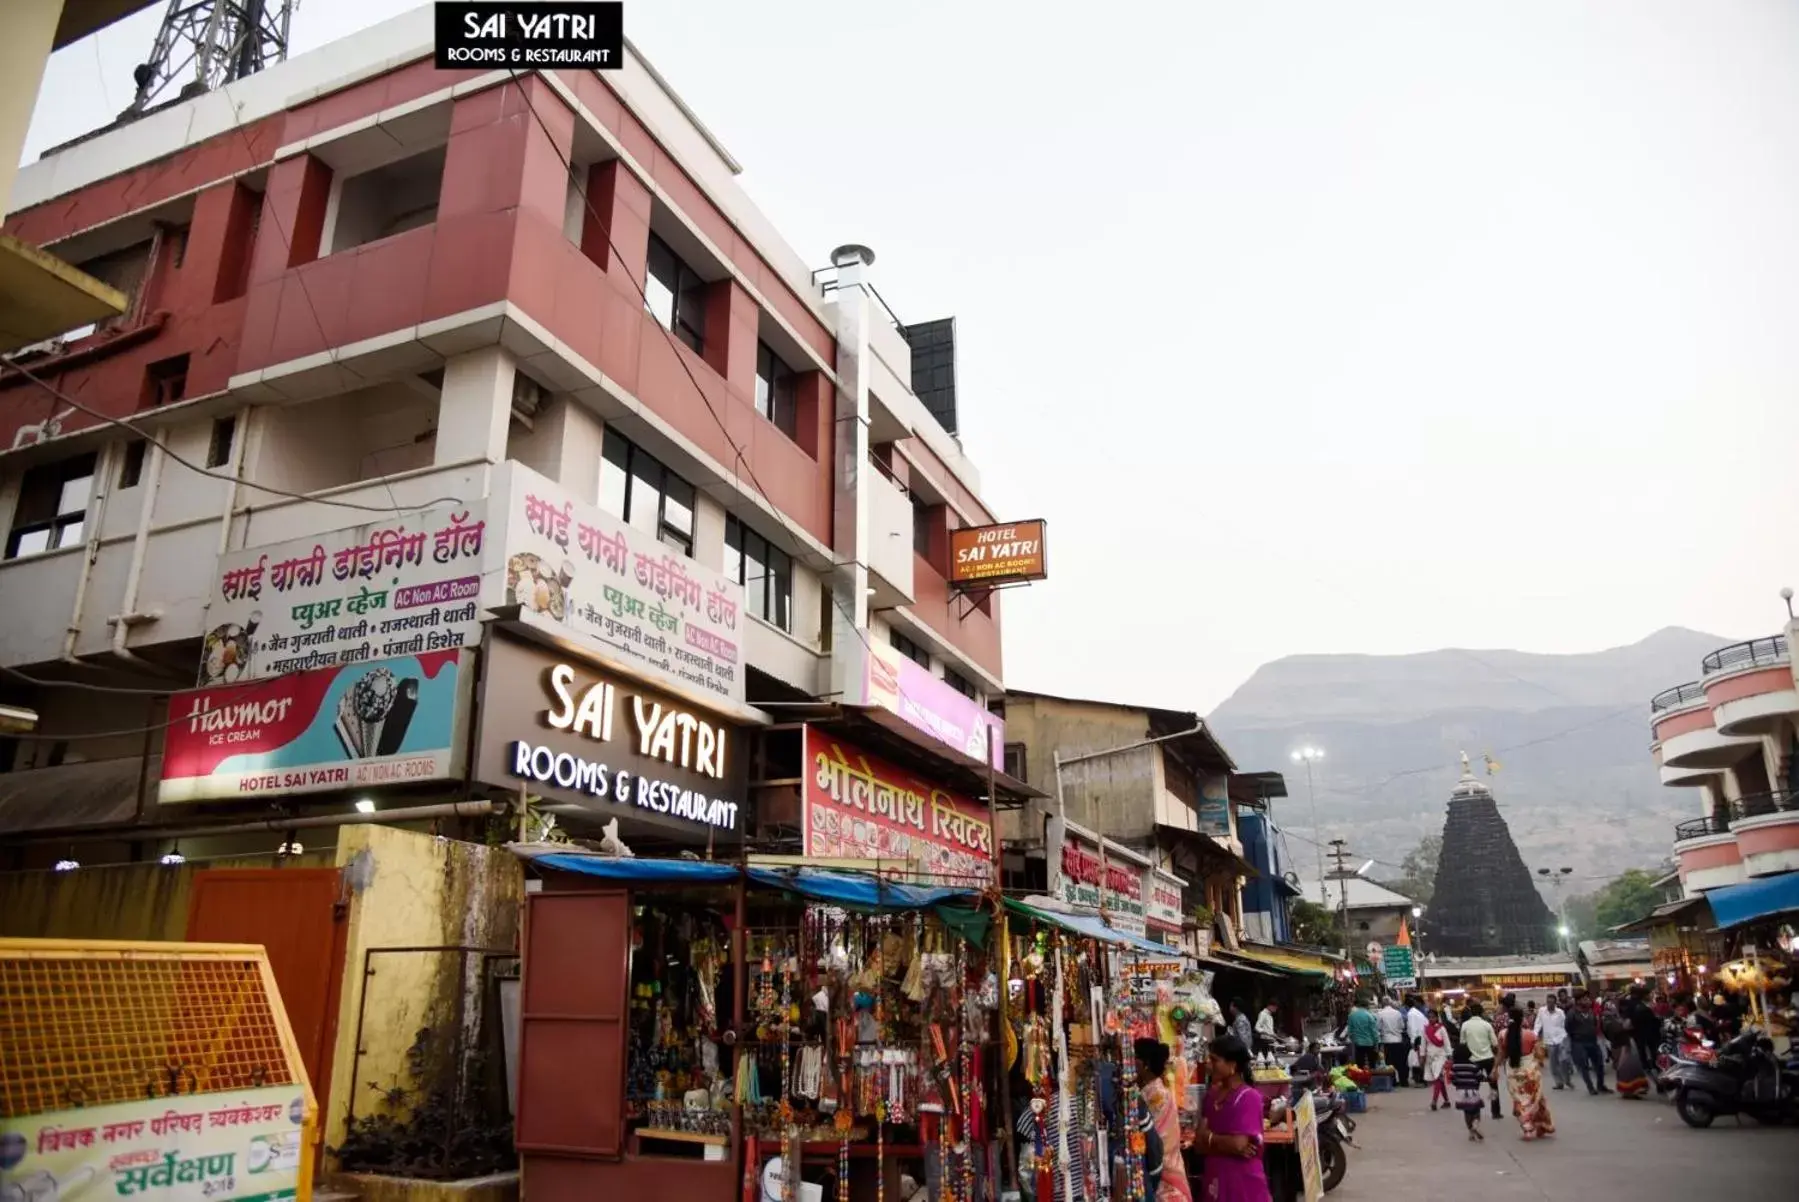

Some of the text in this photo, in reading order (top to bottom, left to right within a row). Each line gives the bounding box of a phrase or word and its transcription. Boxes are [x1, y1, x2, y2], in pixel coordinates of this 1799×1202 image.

[957, 540, 1039, 563] SAI YATRI
[977, 528, 1017, 543] HOTEL
[222, 554, 268, 603] साई
[332, 525, 428, 581] डाईनिंग
[433, 510, 485, 563] हॉल
[525, 494, 573, 555] साई
[707, 582, 737, 632] हॉल
[995, 561, 1006, 569] AC
[291, 585, 389, 629] प्युअर व्हेज
[396, 580, 479, 607] AC Non AC Room
[268, 634, 288, 651] जैन
[290, 625, 336, 652] गुजराती
[380, 608, 440, 634] राजस्थानी
[426, 629, 465, 650] डिशेस
[186, 695, 293, 733] Havmor
[548, 664, 725, 779] SAI YATRI
[209, 729, 261, 745] ICE CREAM
[239, 774, 282, 792] HOTEL
[284, 771, 307, 788] SAI
[307, 768, 349, 786] YATRI
[516, 740, 738, 830] ROOMS & RESTAURANT
[816, 743, 925, 830] भोलेनाथ
[103, 1120, 145, 1142] नगर
[116, 1149, 236, 1196] सर्वेक्षण
